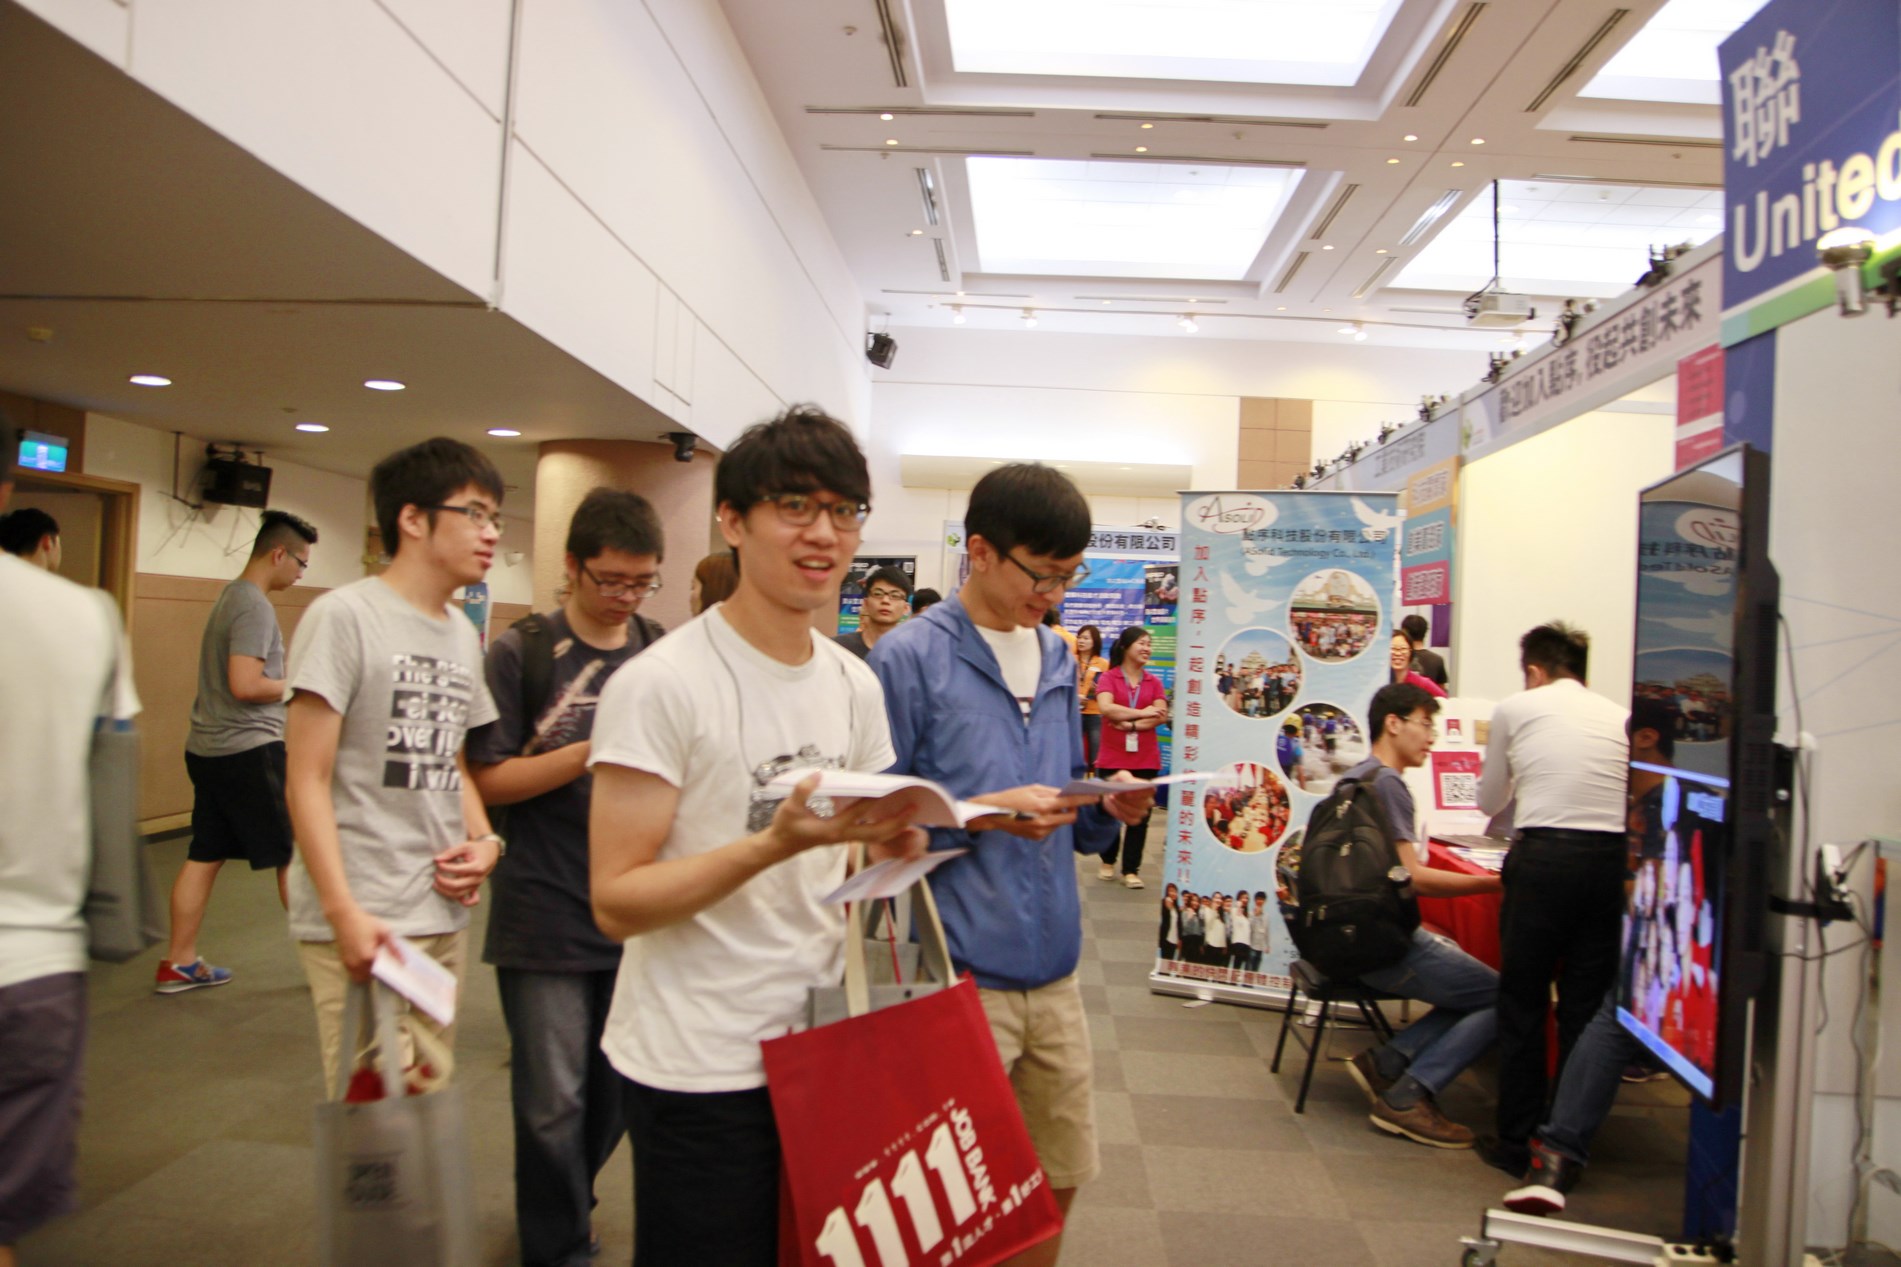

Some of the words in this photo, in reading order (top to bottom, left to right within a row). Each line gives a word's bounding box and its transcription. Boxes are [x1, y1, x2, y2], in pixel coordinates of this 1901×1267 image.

[1728, 29, 1801, 168] 聯
[815, 1121, 978, 1267] 1111
[950, 1107, 977, 1152] JOB
[964, 1145, 998, 1214] BANK
